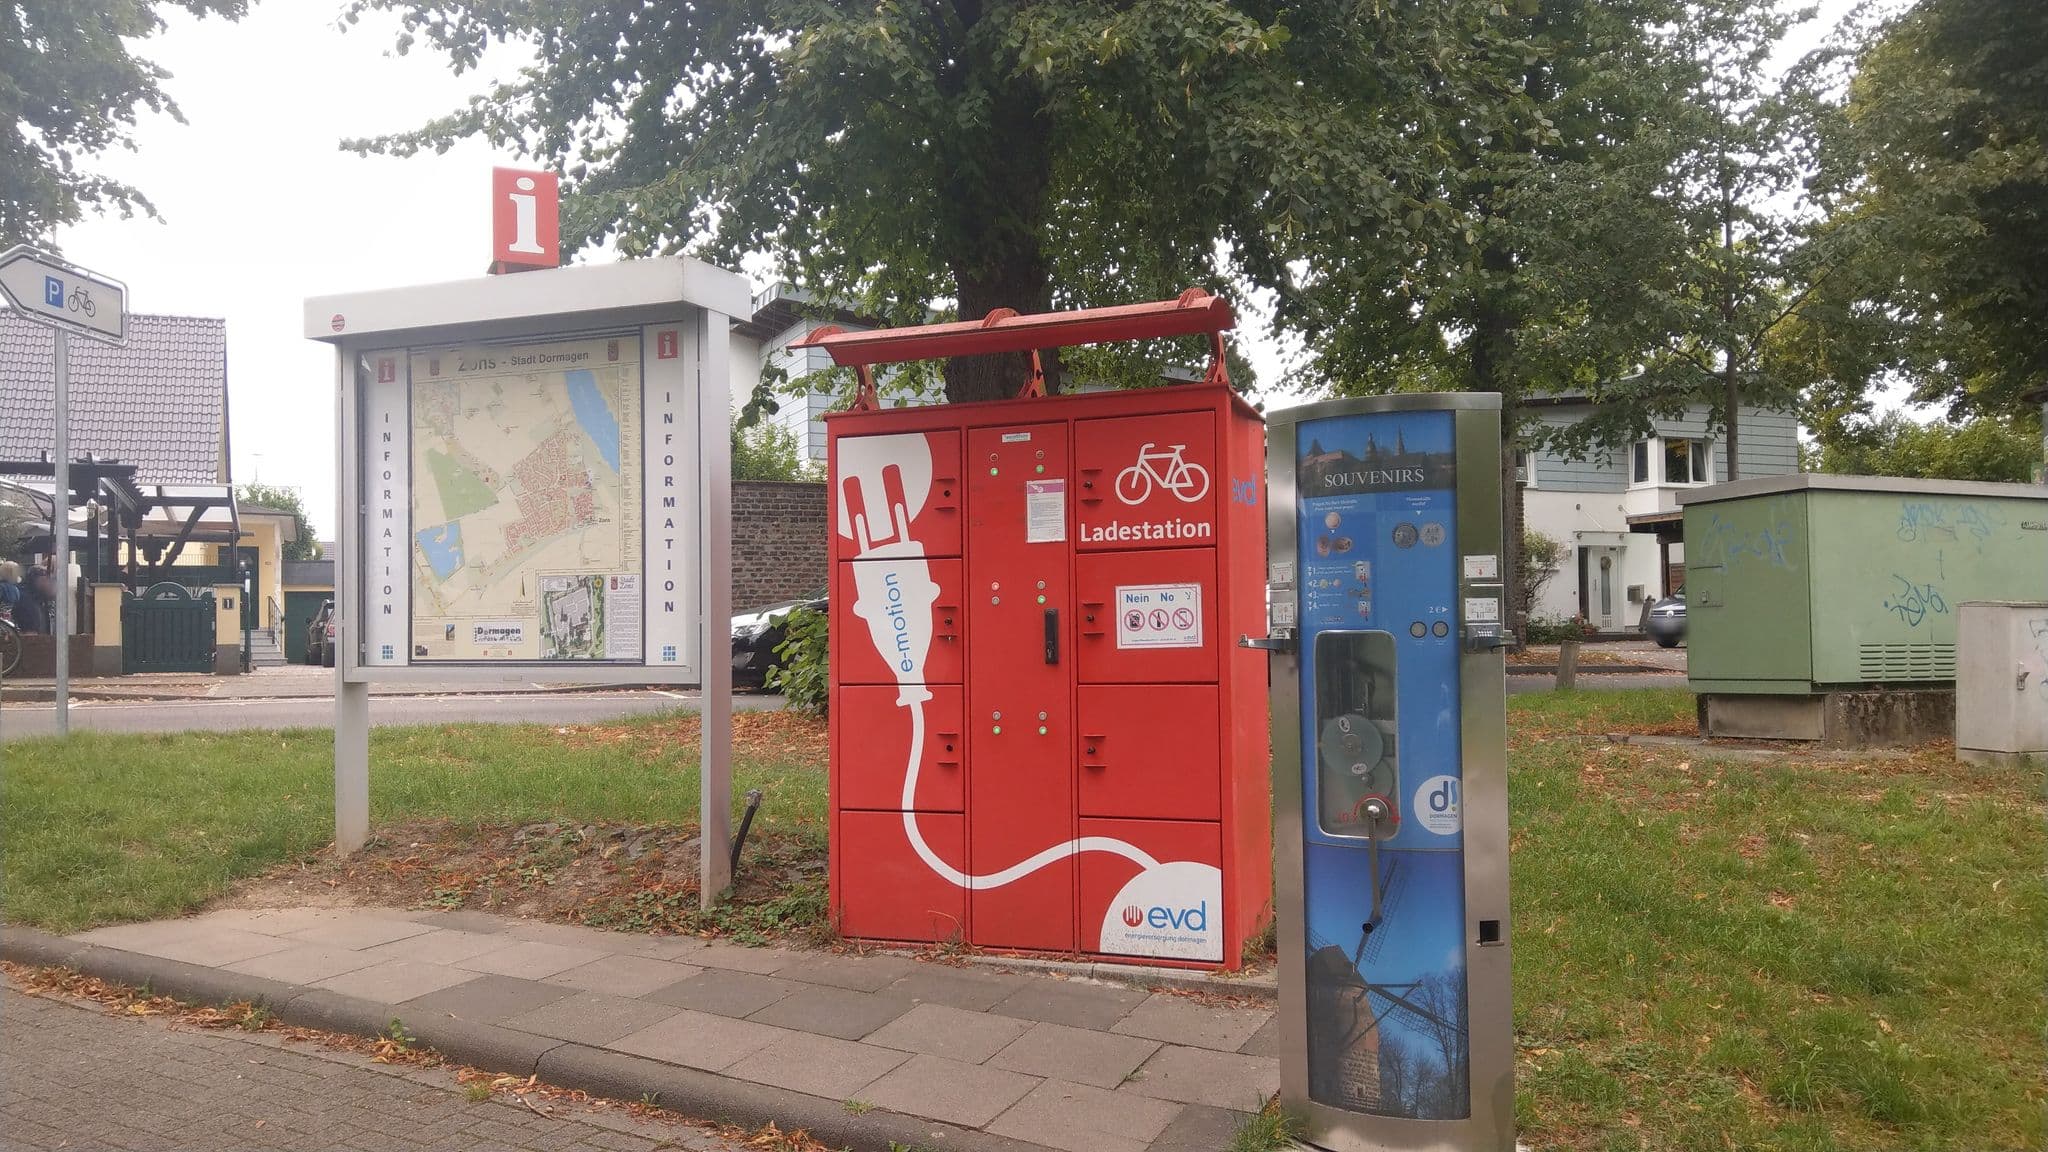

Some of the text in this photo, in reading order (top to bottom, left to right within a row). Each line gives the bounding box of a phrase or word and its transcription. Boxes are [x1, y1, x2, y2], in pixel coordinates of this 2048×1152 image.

[509, 177, 545, 254] i
[50, 281, 60, 302] P
[511, 356, 536, 366] Stadt
[540, 352, 589, 364] Dormagen
[1324, 469, 1425, 488] SOUVENIRS
[382, 413, 393, 615] INFORMATION
[663, 392, 675, 612] INFORMATION
[1081, 518, 1211, 542] Ladestation
[1126, 592, 1175, 603] Nein No
[477, 627, 521, 638] Dormagen
[885, 573, 913, 672] e-motion
[1148, 900, 1207, 932] evd
